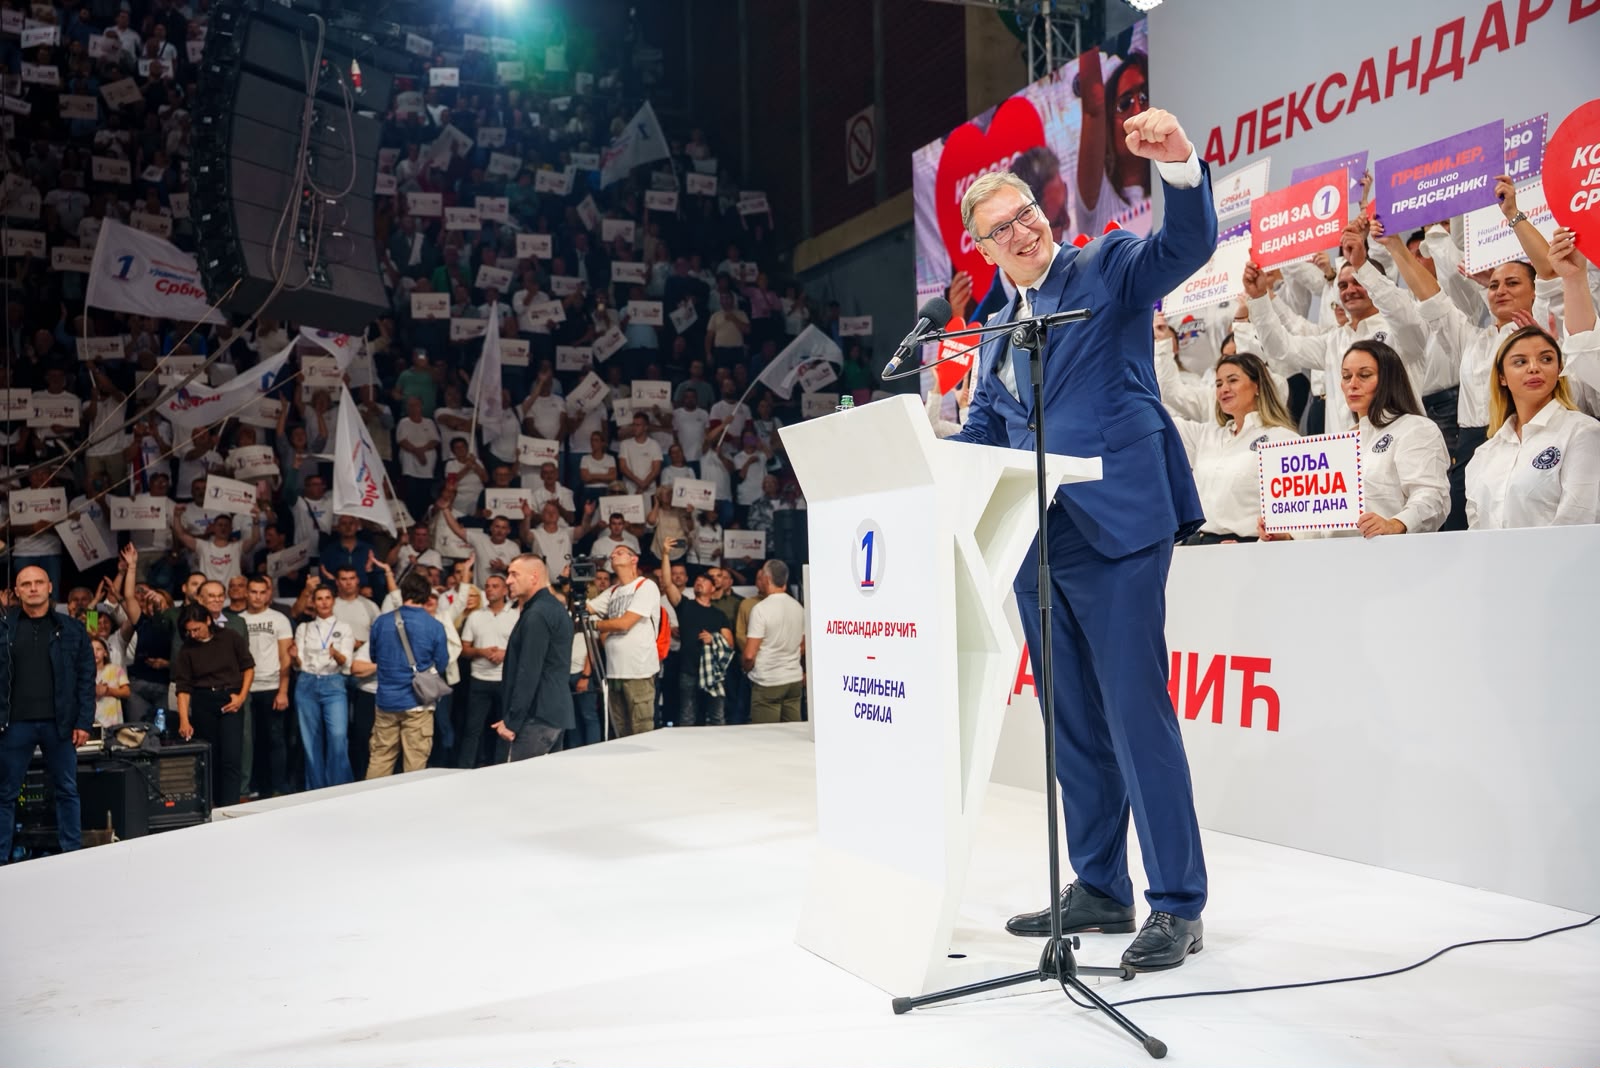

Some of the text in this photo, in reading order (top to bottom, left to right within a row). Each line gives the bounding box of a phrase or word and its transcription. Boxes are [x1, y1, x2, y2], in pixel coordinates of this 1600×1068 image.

[1204, 0, 1554, 167] АЛЕКСАНДАР
[1391, 146, 1486, 188] ПРЕМИЈЕР,
[1417, 171, 1459, 191] баш као
[1391, 174, 1488, 214] ПРЕДСЕДНИК!
[1260, 190, 1332, 232] СВИ ЗА 1
[1258, 233, 1297, 254] ЈЕДАН
[1298, 228, 1315, 243] ЗА
[1315, 219, 1340, 238] СВЕ
[1477, 228, 1514, 246] УЈЕДИЊ
[1182, 284, 1228, 304] ПОБЕЂУЈЕ
[1185, 272, 1229, 293] СРБИЈА
[1281, 452, 1330, 474] БОЉА
[1270, 471, 1347, 499] СРБИЈА
[1271, 497, 1348, 514] СВАКОГ ДАНА
[861, 531, 875, 588] 1
[826, 620, 917, 639] АЛЕКСАНДАР ВУЧИЋ
[842, 675, 906, 699] УЈЕДИЊЕНА
[854, 702, 893, 724] СРБИЈА
